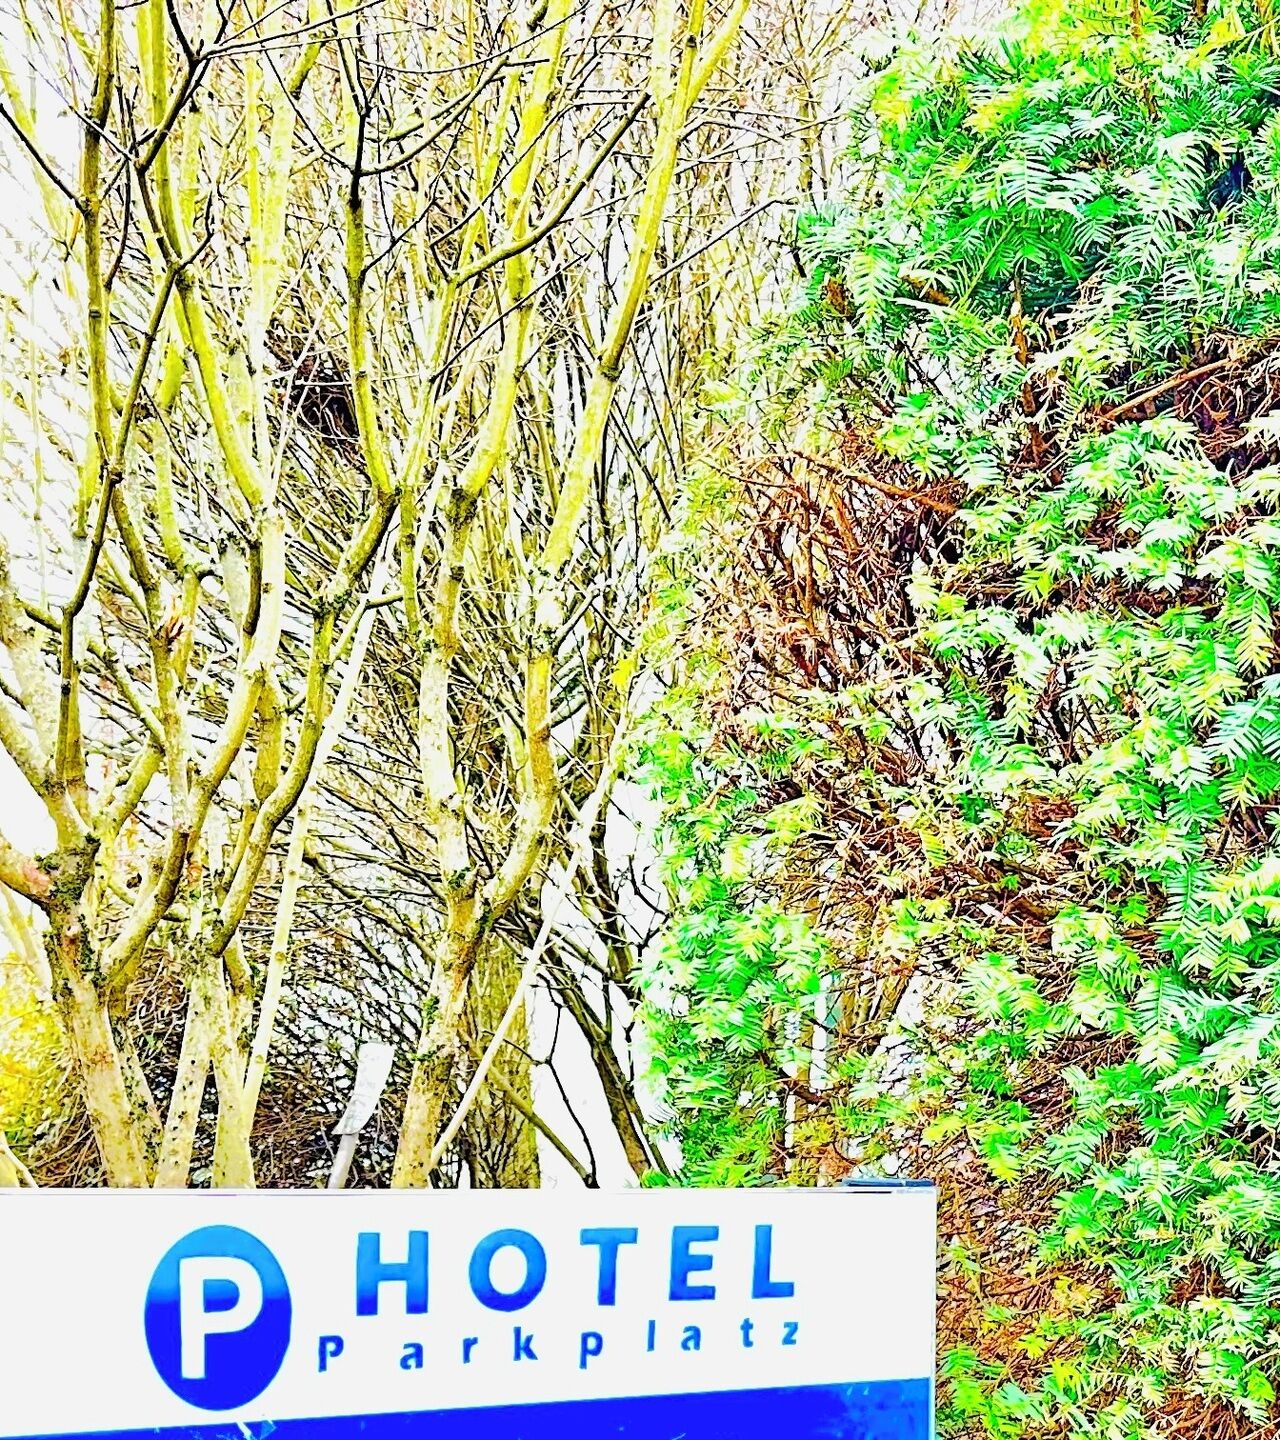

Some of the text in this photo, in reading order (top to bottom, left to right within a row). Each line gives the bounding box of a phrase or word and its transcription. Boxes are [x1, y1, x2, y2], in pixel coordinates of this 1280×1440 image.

[179, 1255, 264, 1380] P
[354, 1222, 796, 1318] HOTEL
[316, 1316, 800, 1374] Parkplatz
